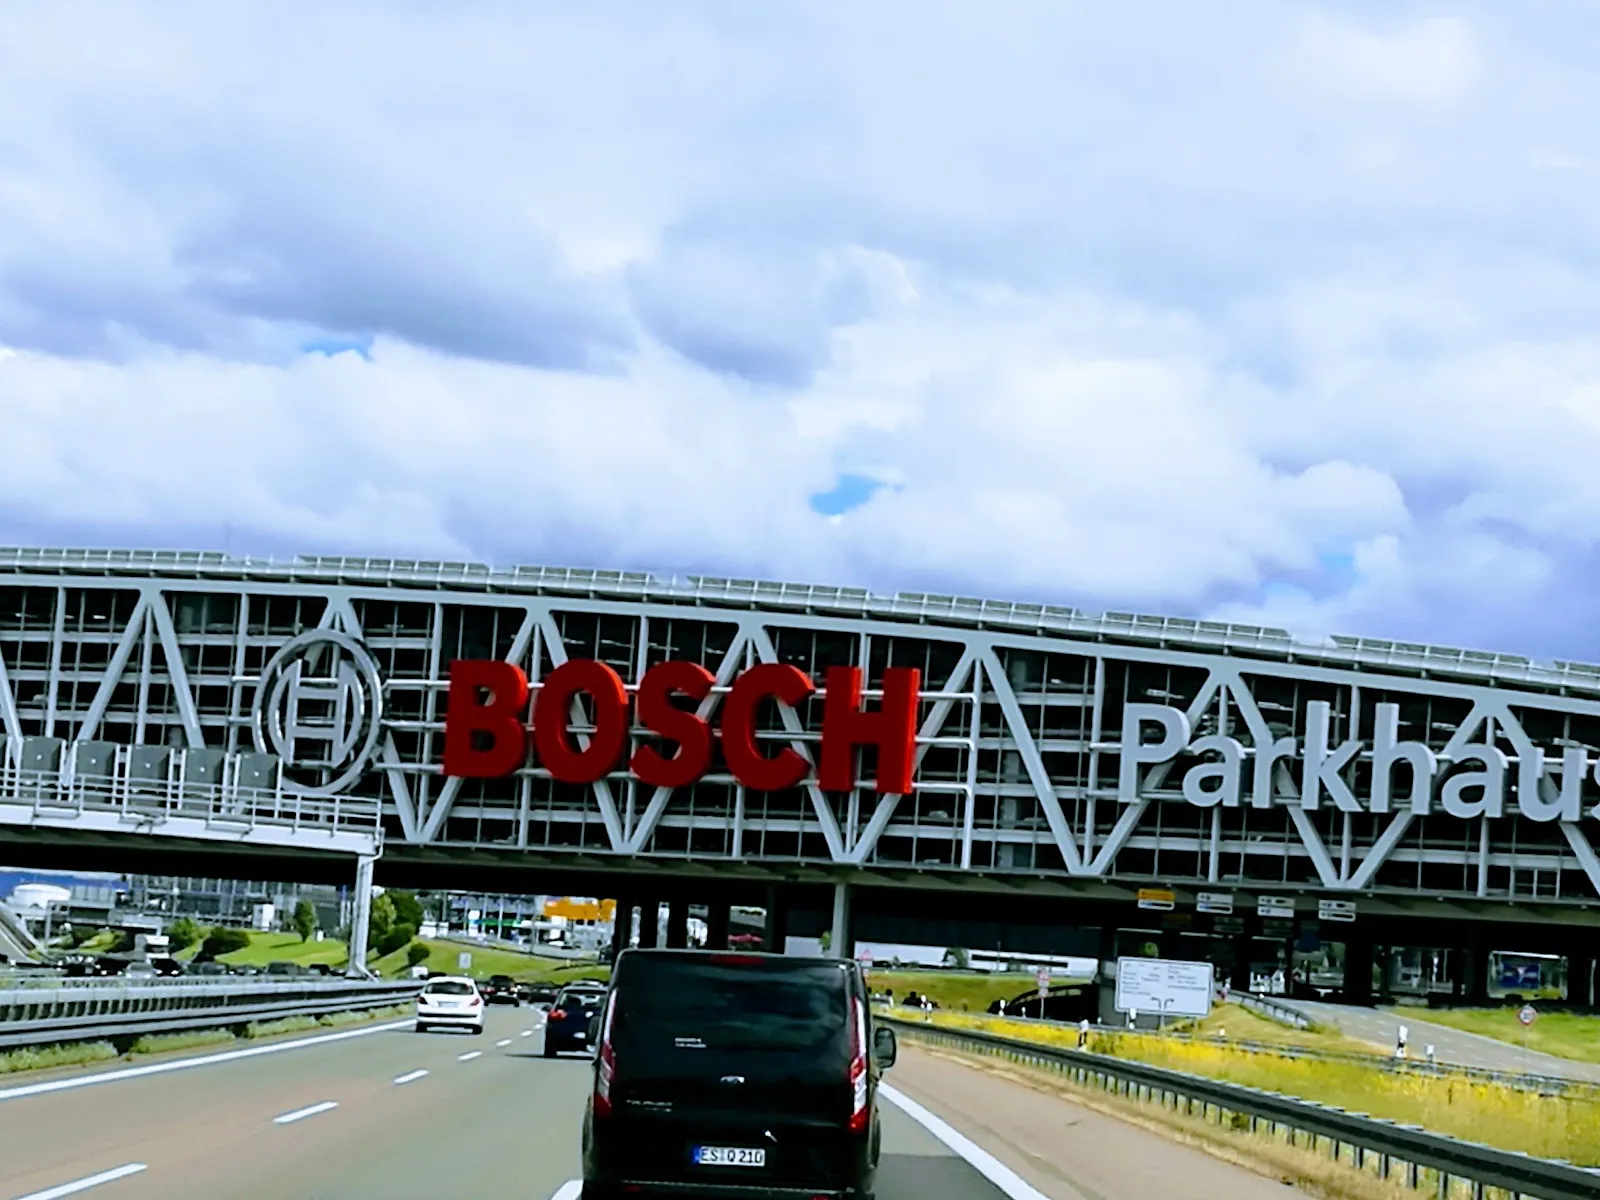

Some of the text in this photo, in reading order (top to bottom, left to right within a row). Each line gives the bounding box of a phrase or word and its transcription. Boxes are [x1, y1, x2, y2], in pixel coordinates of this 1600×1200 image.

[443, 658, 1600, 822] BOSCH Parkhau
[701, 1147, 718, 1161] ES
[739, 1149, 763, 1164] 210
